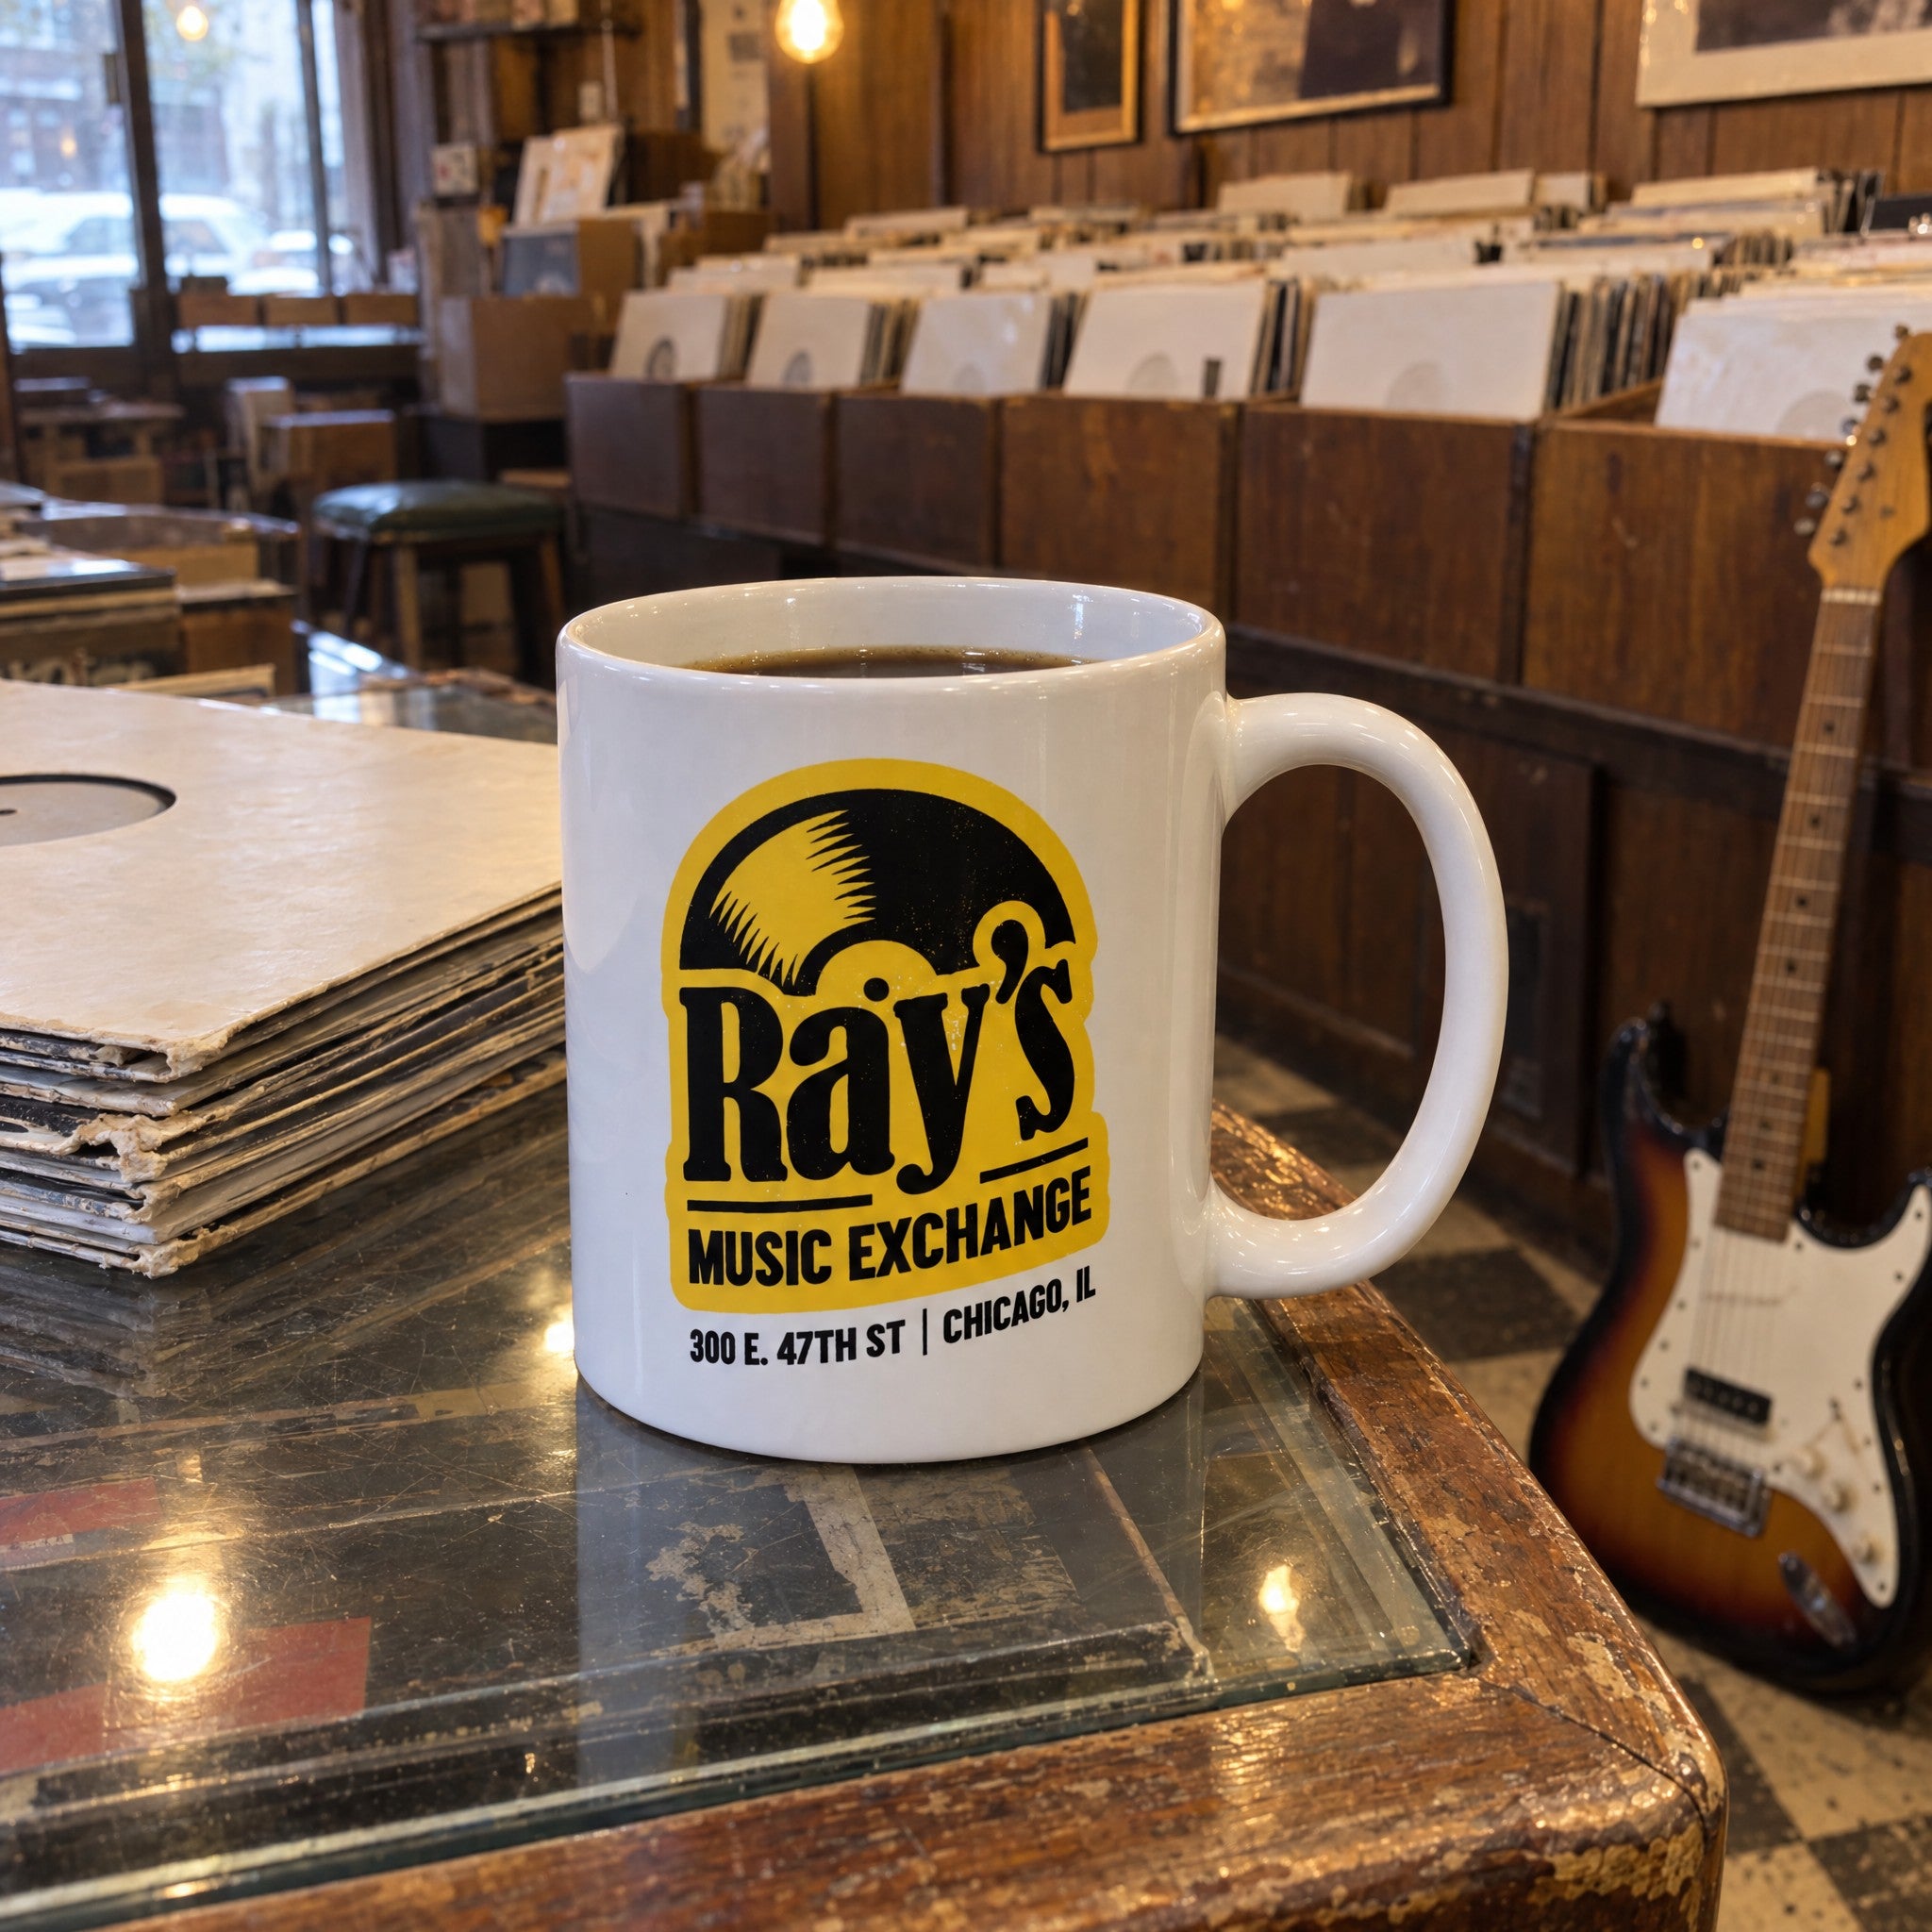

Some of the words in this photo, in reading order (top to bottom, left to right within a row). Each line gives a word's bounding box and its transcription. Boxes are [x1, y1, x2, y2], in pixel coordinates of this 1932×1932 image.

[678, 919, 1075, 1195] Ray's
[688, 1228, 832, 1287] MUSIC
[848, 1165, 1091, 1282] EXCHANGE
[690, 1328, 736, 1365] 300
[743, 1332, 769, 1366] E.
[776, 1326, 858, 1366] 47TH
[866, 1319, 906, 1358] ST
[942, 1278, 1070, 1344] CHICAGO,
[1075, 1265, 1096, 1304] IL
